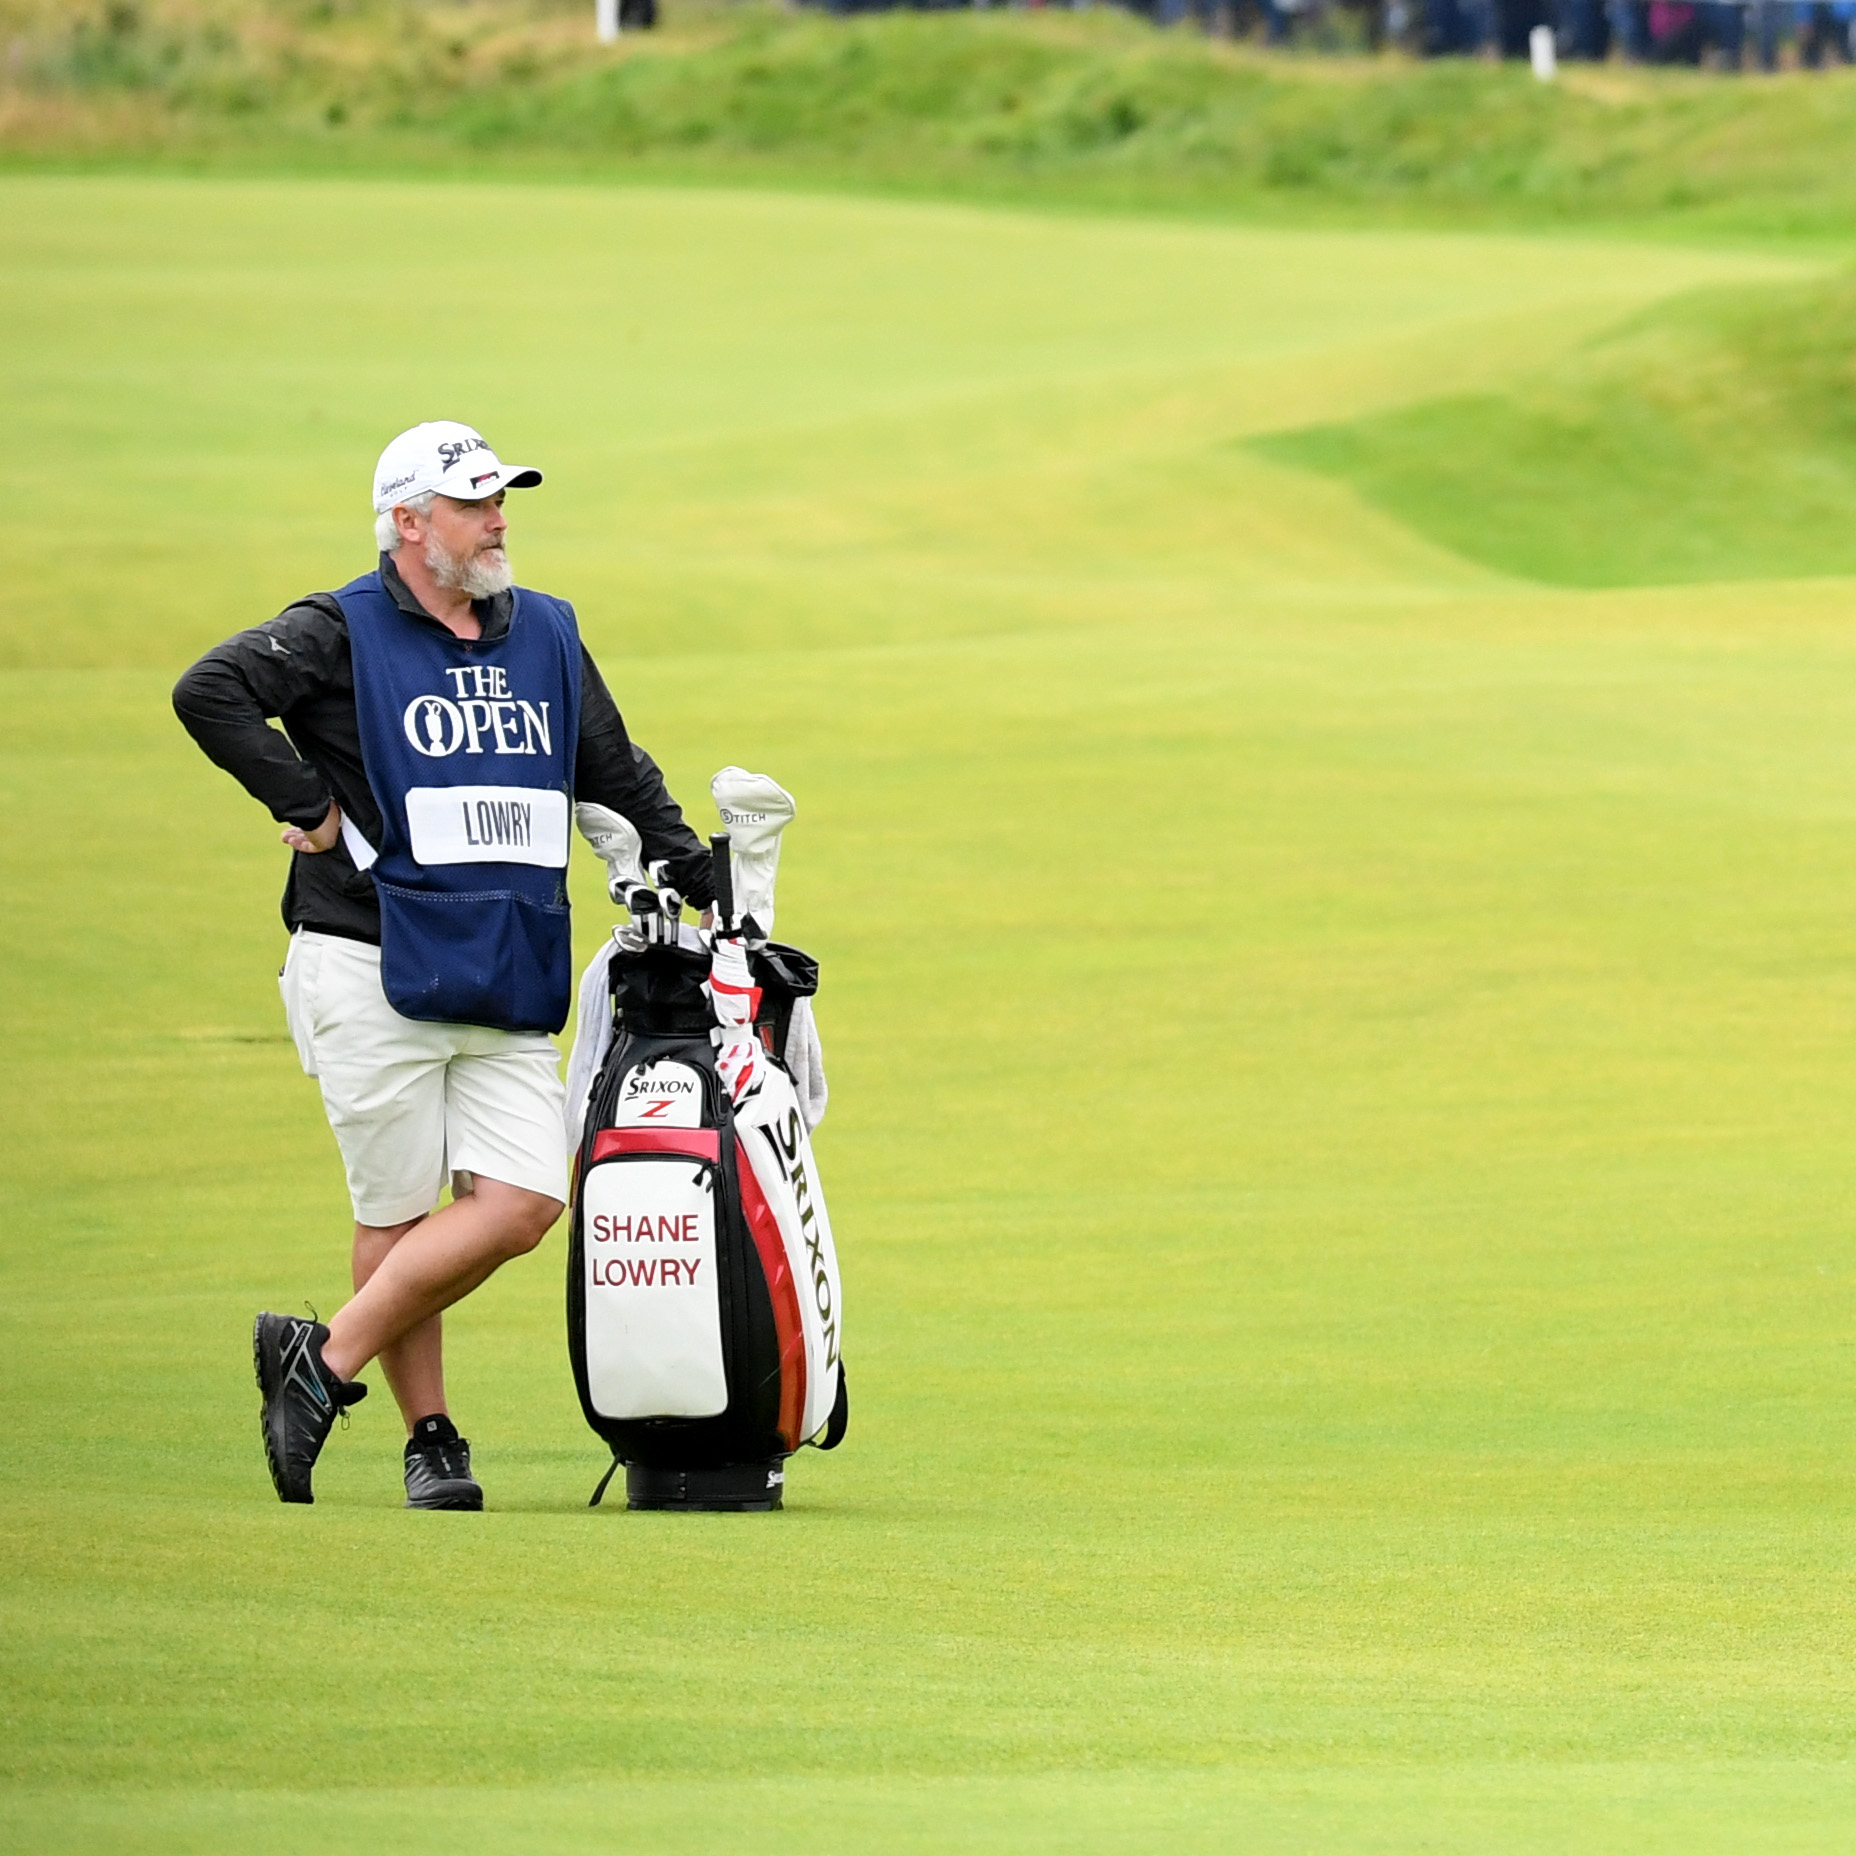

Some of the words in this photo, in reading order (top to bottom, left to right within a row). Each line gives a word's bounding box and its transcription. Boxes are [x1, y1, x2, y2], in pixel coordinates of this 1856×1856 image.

[380, 469, 417, 497] Cleveland
[445, 665, 513, 698] THE
[403, 694, 552, 757] OPEN
[462, 799, 532, 848] LOWRY
[719, 808, 767, 825] STITCH
[626, 1077, 695, 1101] SRIXON
[637, 1100, 677, 1118] Z
[592, 1214, 700, 1242] SHANE
[755, 1105, 838, 1373] SRIXON
[592, 1258, 702, 1286] LOWRY
